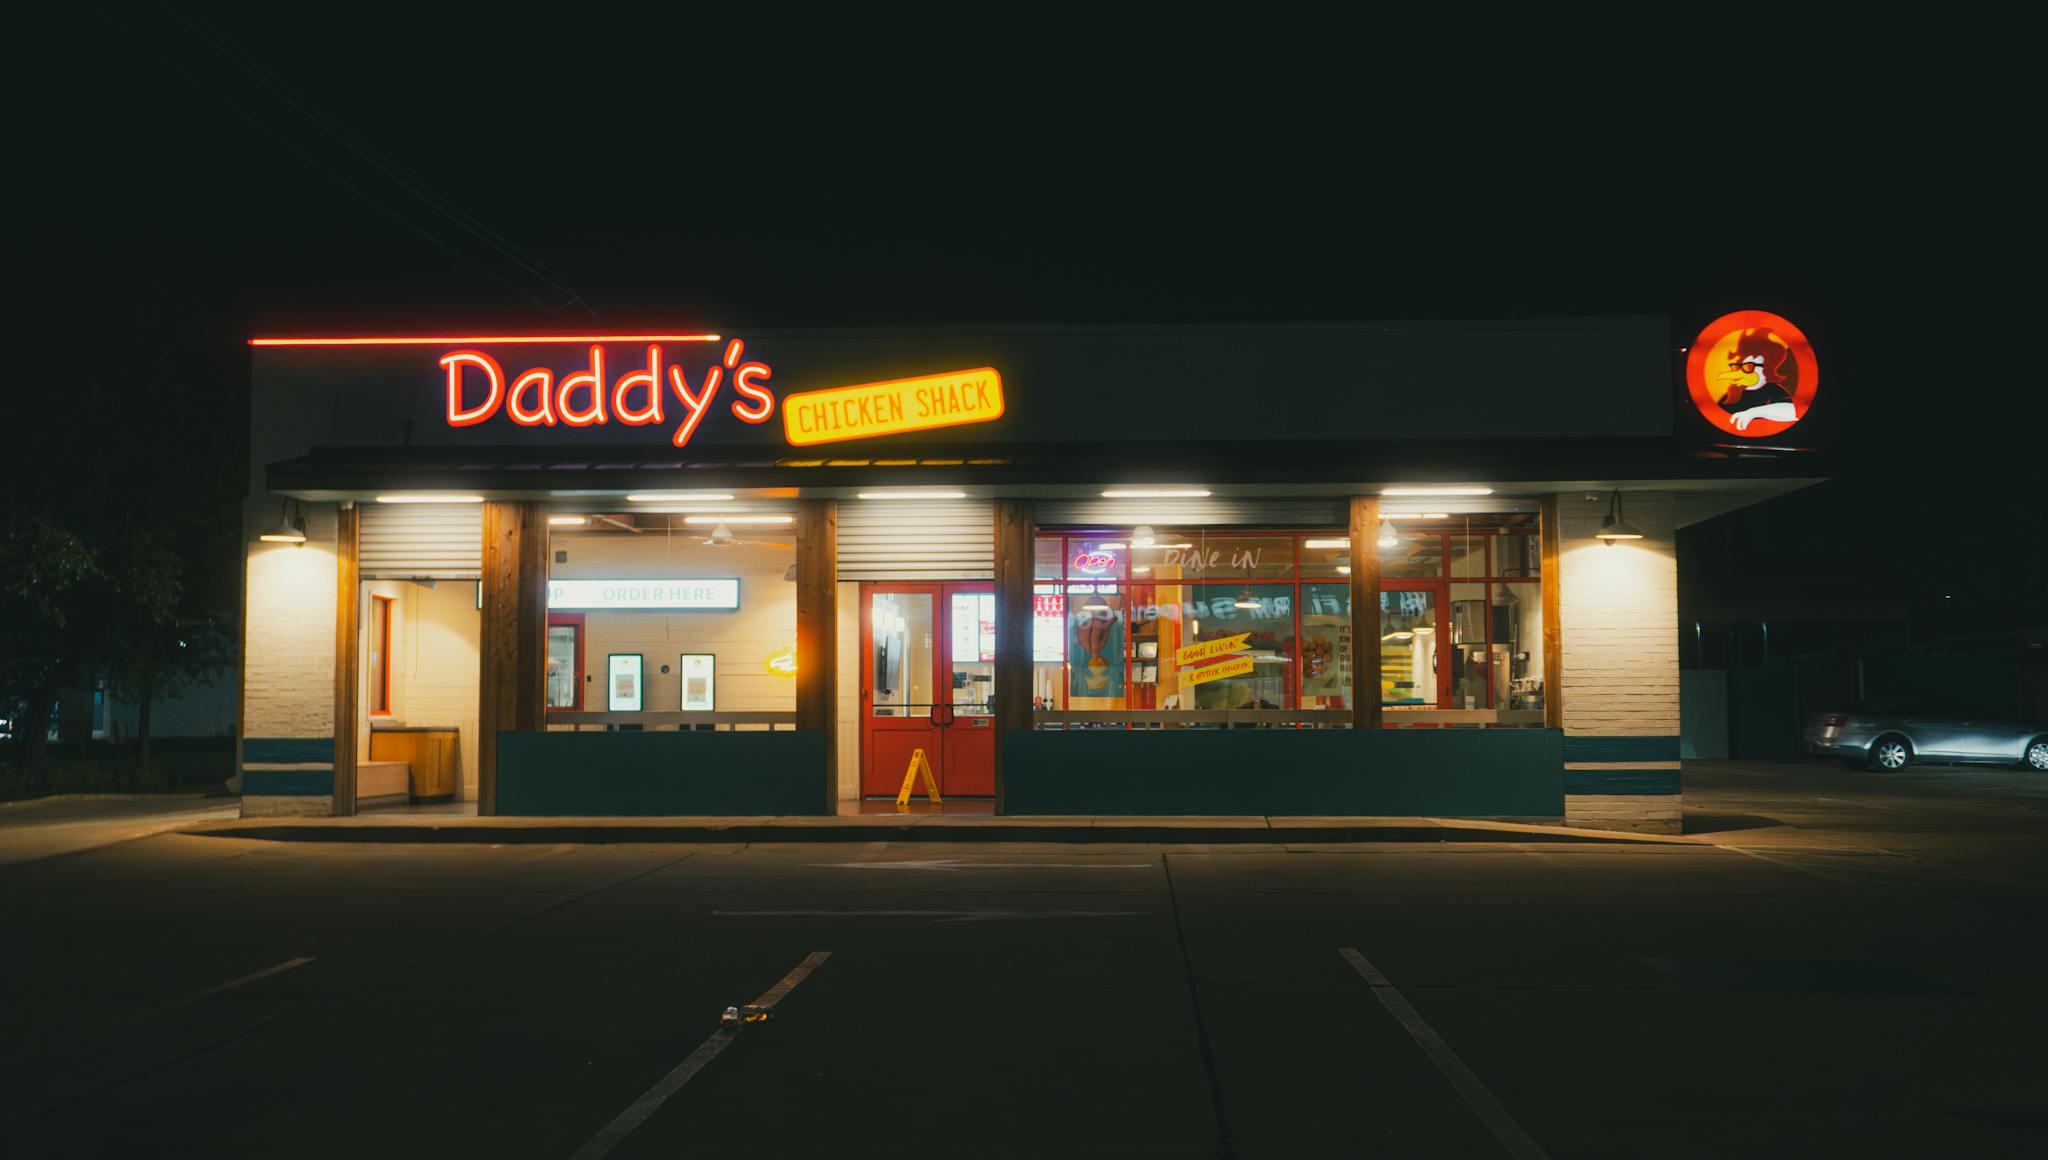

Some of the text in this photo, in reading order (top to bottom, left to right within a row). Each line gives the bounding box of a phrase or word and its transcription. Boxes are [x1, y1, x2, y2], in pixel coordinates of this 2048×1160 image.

[440, 338, 775, 447] Daddy's
[798, 380, 992, 433] CHICKEN SHACK
[1074, 552, 1116, 570] Open
[602, 587, 663, 601] ORDER
[669, 587, 717, 600] HERE
